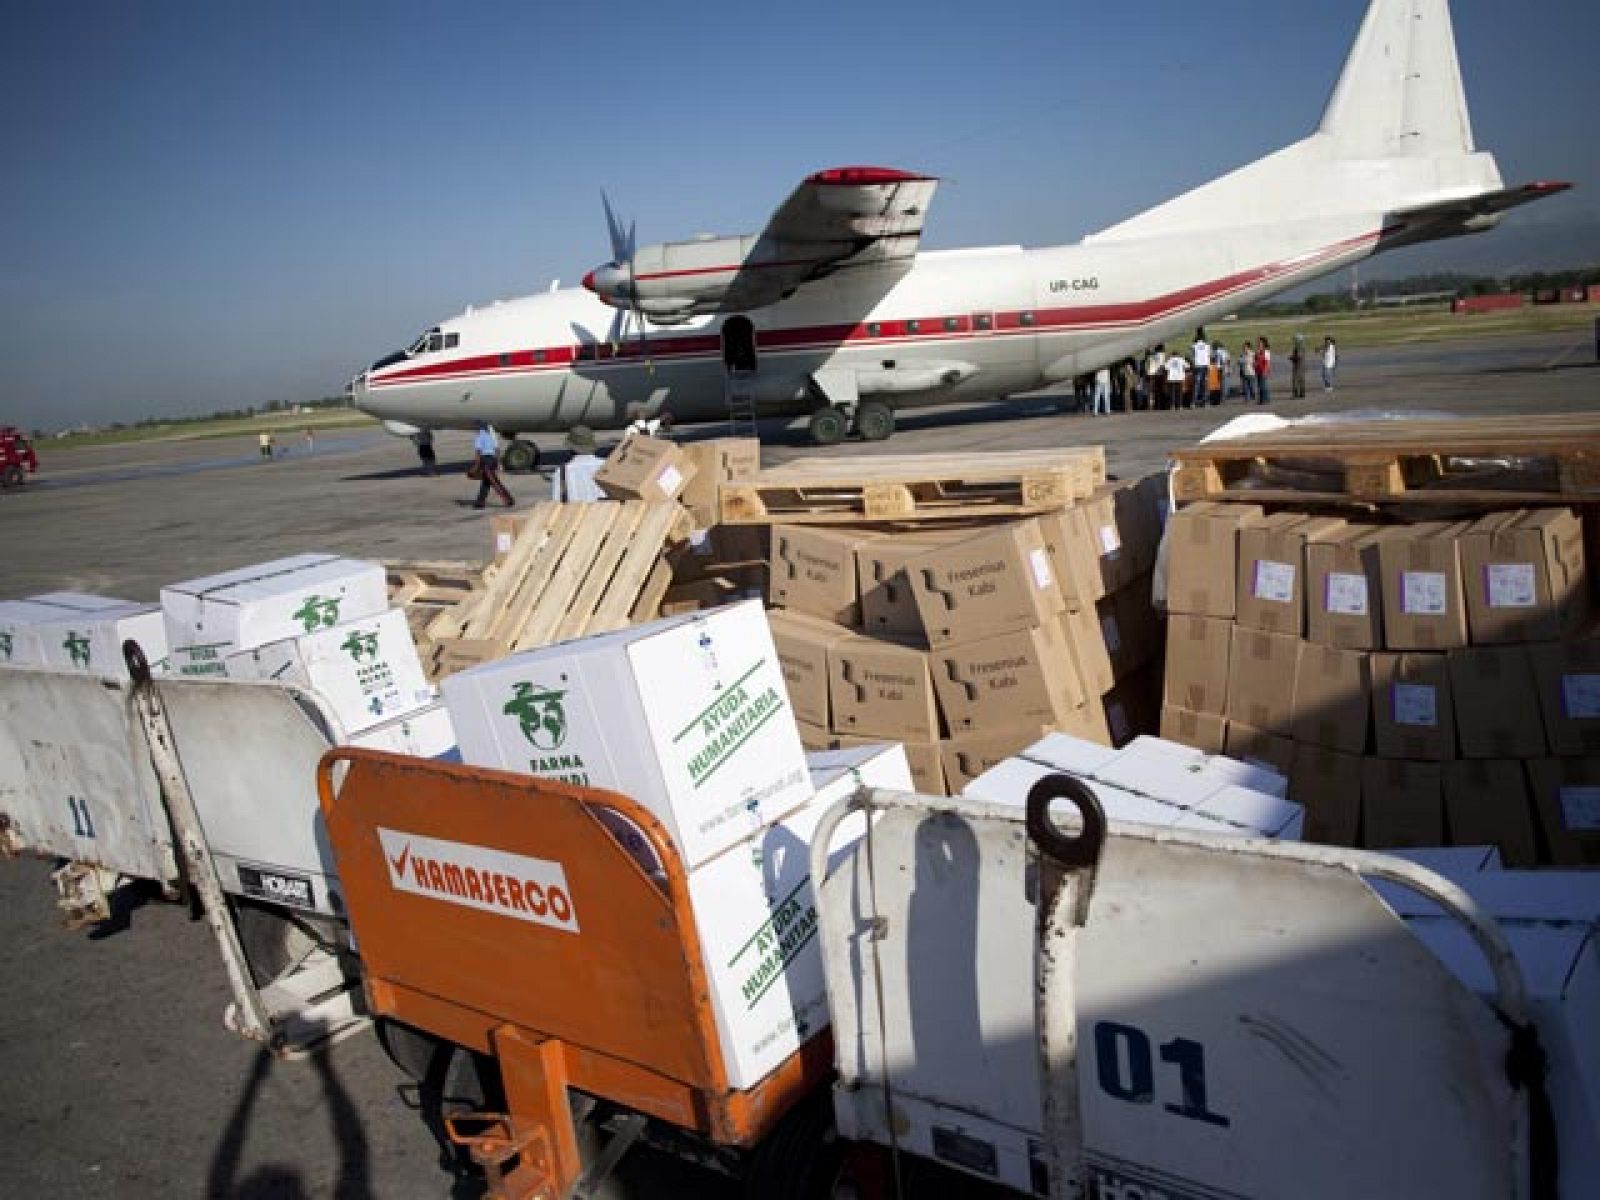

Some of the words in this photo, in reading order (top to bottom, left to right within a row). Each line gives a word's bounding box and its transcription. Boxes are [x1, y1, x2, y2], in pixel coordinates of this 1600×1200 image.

[947, 559, 1006, 583] Fresenius
[968, 655, 1029, 675] Fresenius
[687, 687, 780, 779] HUMANITARIA
[703, 687, 749, 738] AYUDA
[530, 754, 584, 772] FARMA
[410, 855, 571, 922] HAMASERCO
[741, 905, 818, 1001] HUMANITAR
[755, 898, 802, 957] AYUDA
[1094, 1020, 1231, 1128] 01
